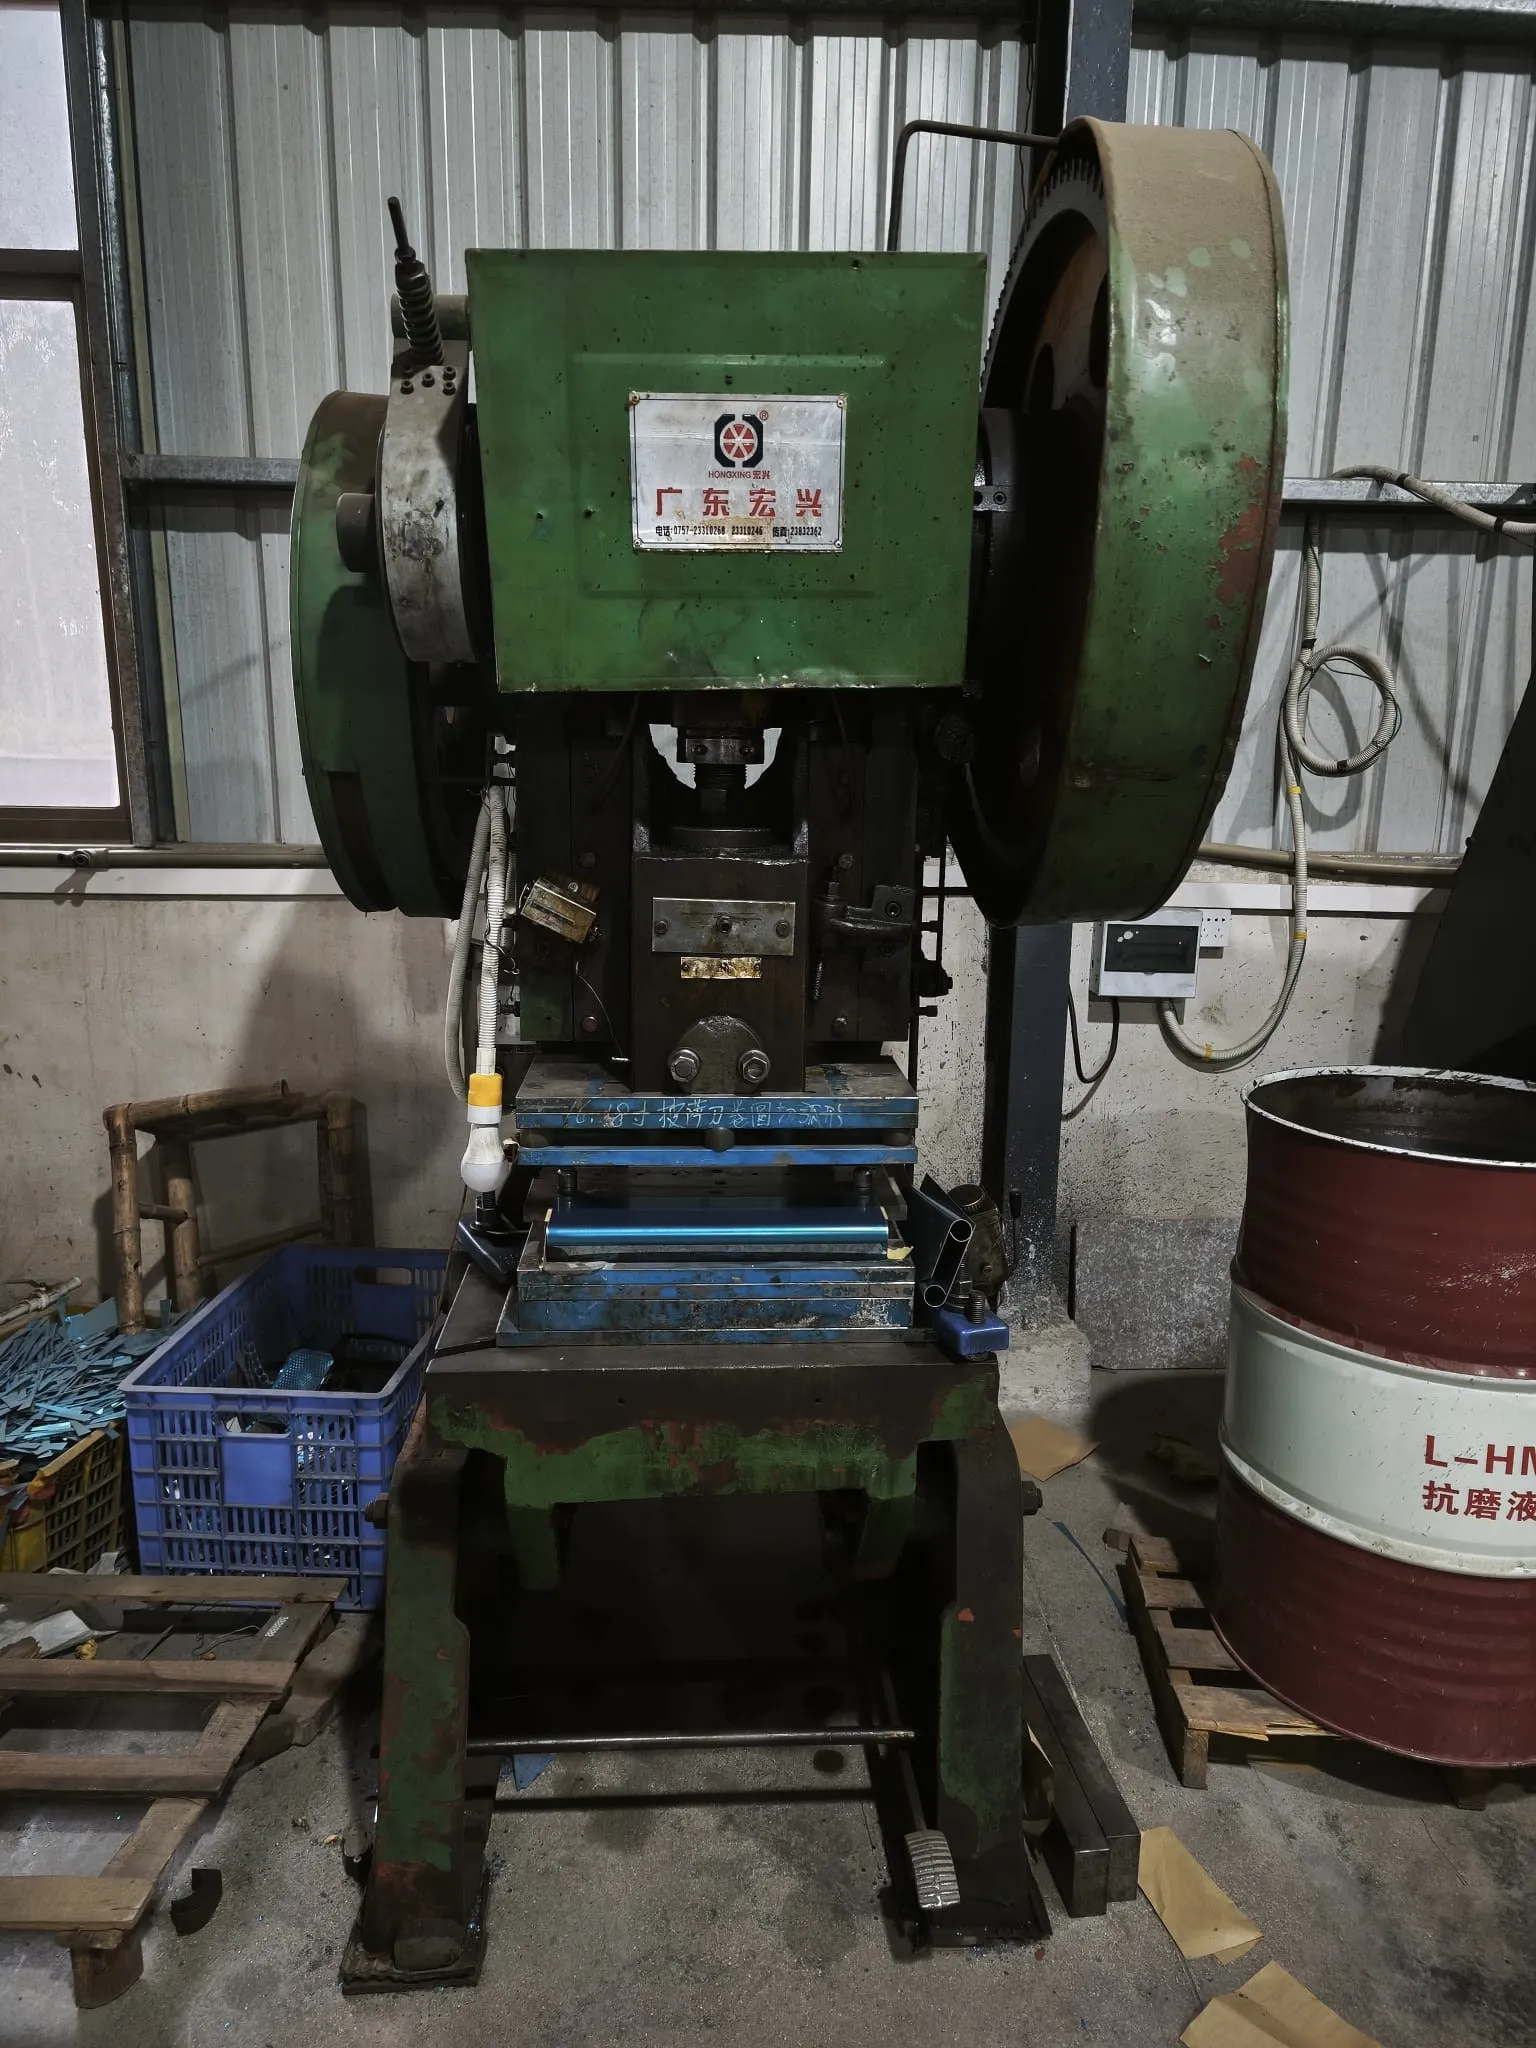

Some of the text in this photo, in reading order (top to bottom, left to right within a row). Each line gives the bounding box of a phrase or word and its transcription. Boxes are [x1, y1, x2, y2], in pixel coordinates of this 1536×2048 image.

[708, 471, 751, 479] HONGXING
[656, 487, 822, 517] 广东宏兴
[1422, 1480, 1536, 1521] 抗磨液
